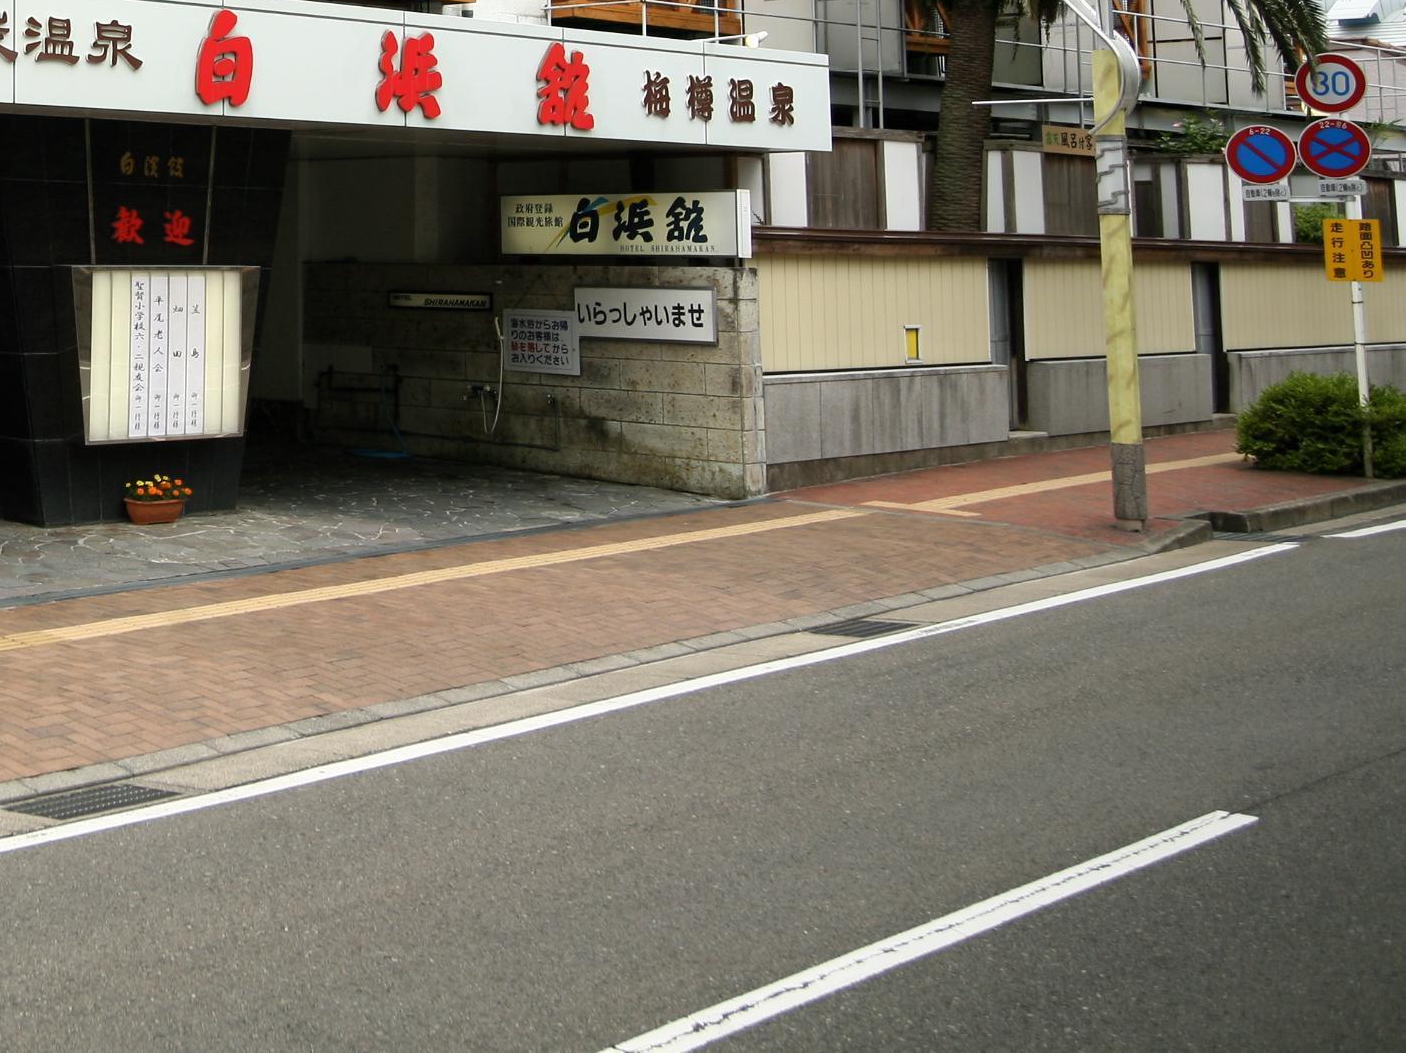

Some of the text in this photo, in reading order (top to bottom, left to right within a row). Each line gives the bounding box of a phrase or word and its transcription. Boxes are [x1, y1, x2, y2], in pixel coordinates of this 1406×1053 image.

[1312, 71, 1350, 96] 30
[642, 69, 795, 127] 梅樽温泉
[1249, 127, 1271, 136] 6-22
[515, 202, 554, 214] 政府登録
[507, 215, 563, 228] 国際観光旅館
[1330, 222, 1346, 278] 走行注意
[1359, 222, 1375, 279] 路面凸凹あり
[577, 302, 704, 328] いらっしゃいませ
[511, 353, 569, 366] お入りください
